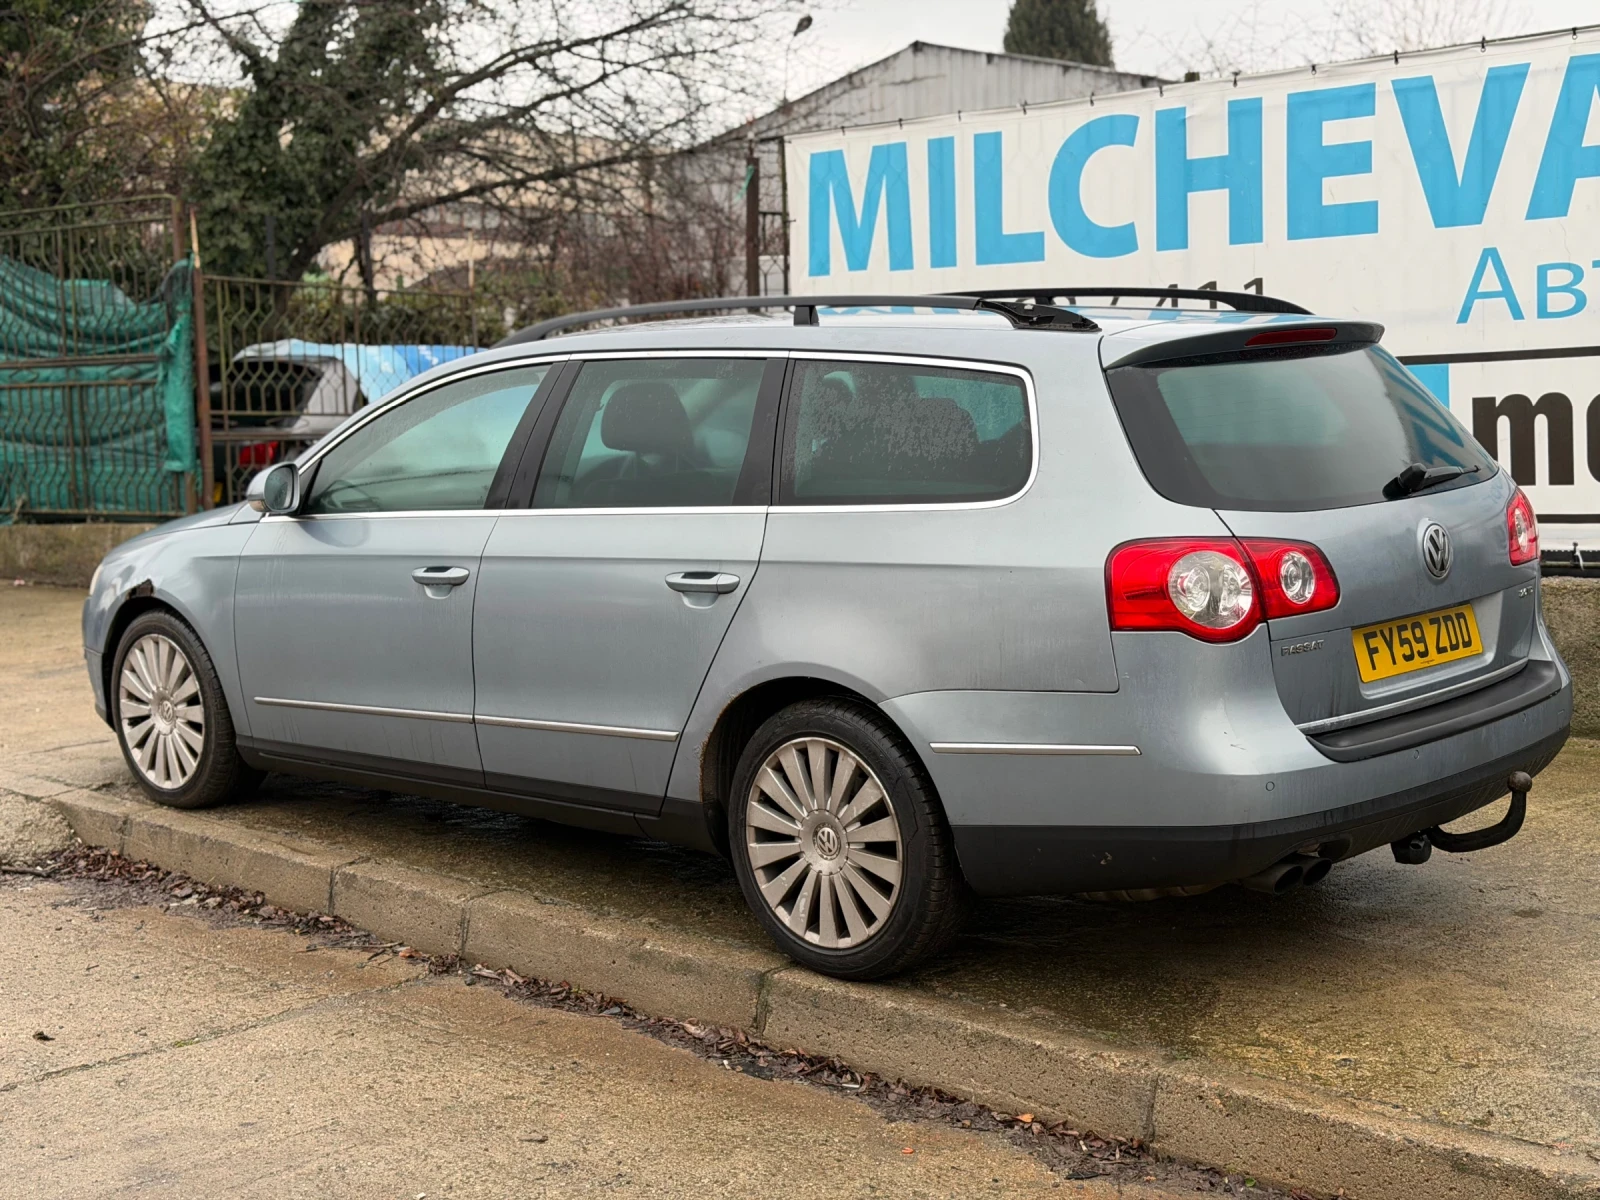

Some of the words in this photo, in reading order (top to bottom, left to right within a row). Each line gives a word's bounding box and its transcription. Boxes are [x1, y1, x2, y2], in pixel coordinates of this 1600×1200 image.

[1472, 391, 1600, 487] m
[1281, 639, 1325, 656] PASSAT
[1362, 621, 1430, 671] FY59
[1428, 611, 1473, 655] ZDD
